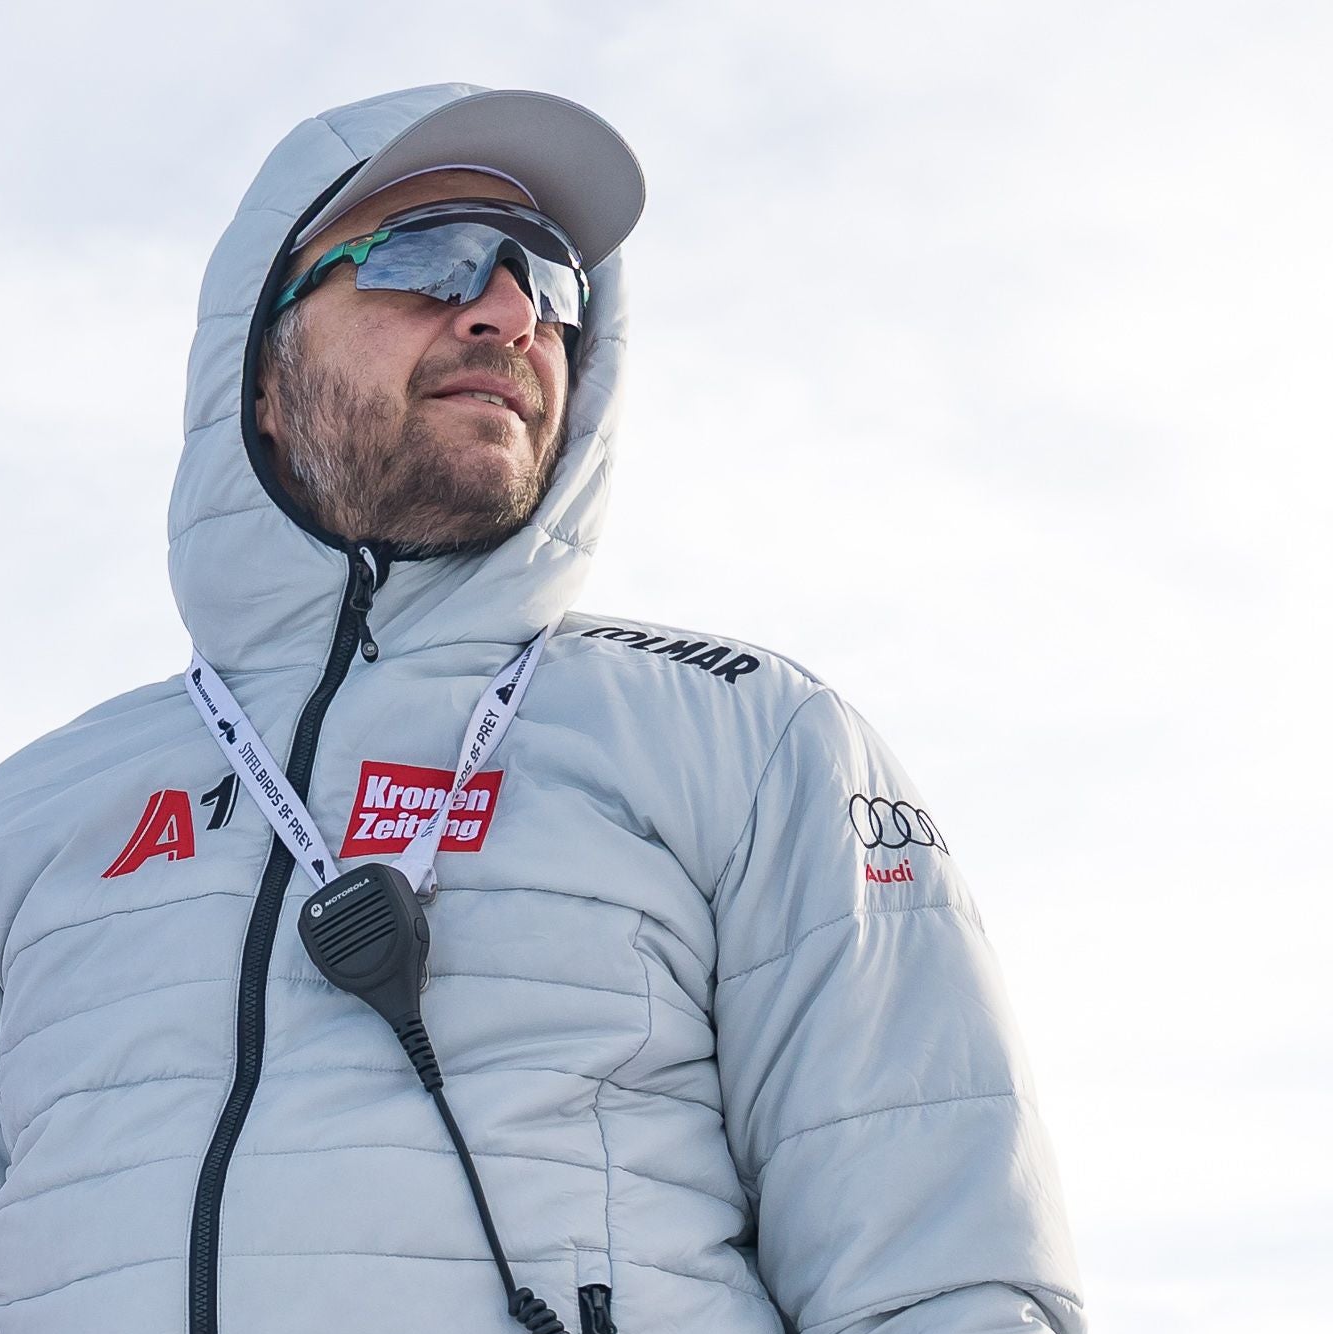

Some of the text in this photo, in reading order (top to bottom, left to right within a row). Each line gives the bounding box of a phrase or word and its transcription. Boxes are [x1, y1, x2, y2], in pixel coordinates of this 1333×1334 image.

[580, 627, 761, 685] COLMAR
[470, 742, 482, 764] OF
[476, 707, 500, 747] PREY
[238, 741, 314, 853] STIFEL BIRDS OF PREY
[362, 775, 491, 812] Kronen
[100, 771, 241, 880] A1
[324, 877, 370, 907] MOTOROLA
[865, 858, 914, 884] Audi
